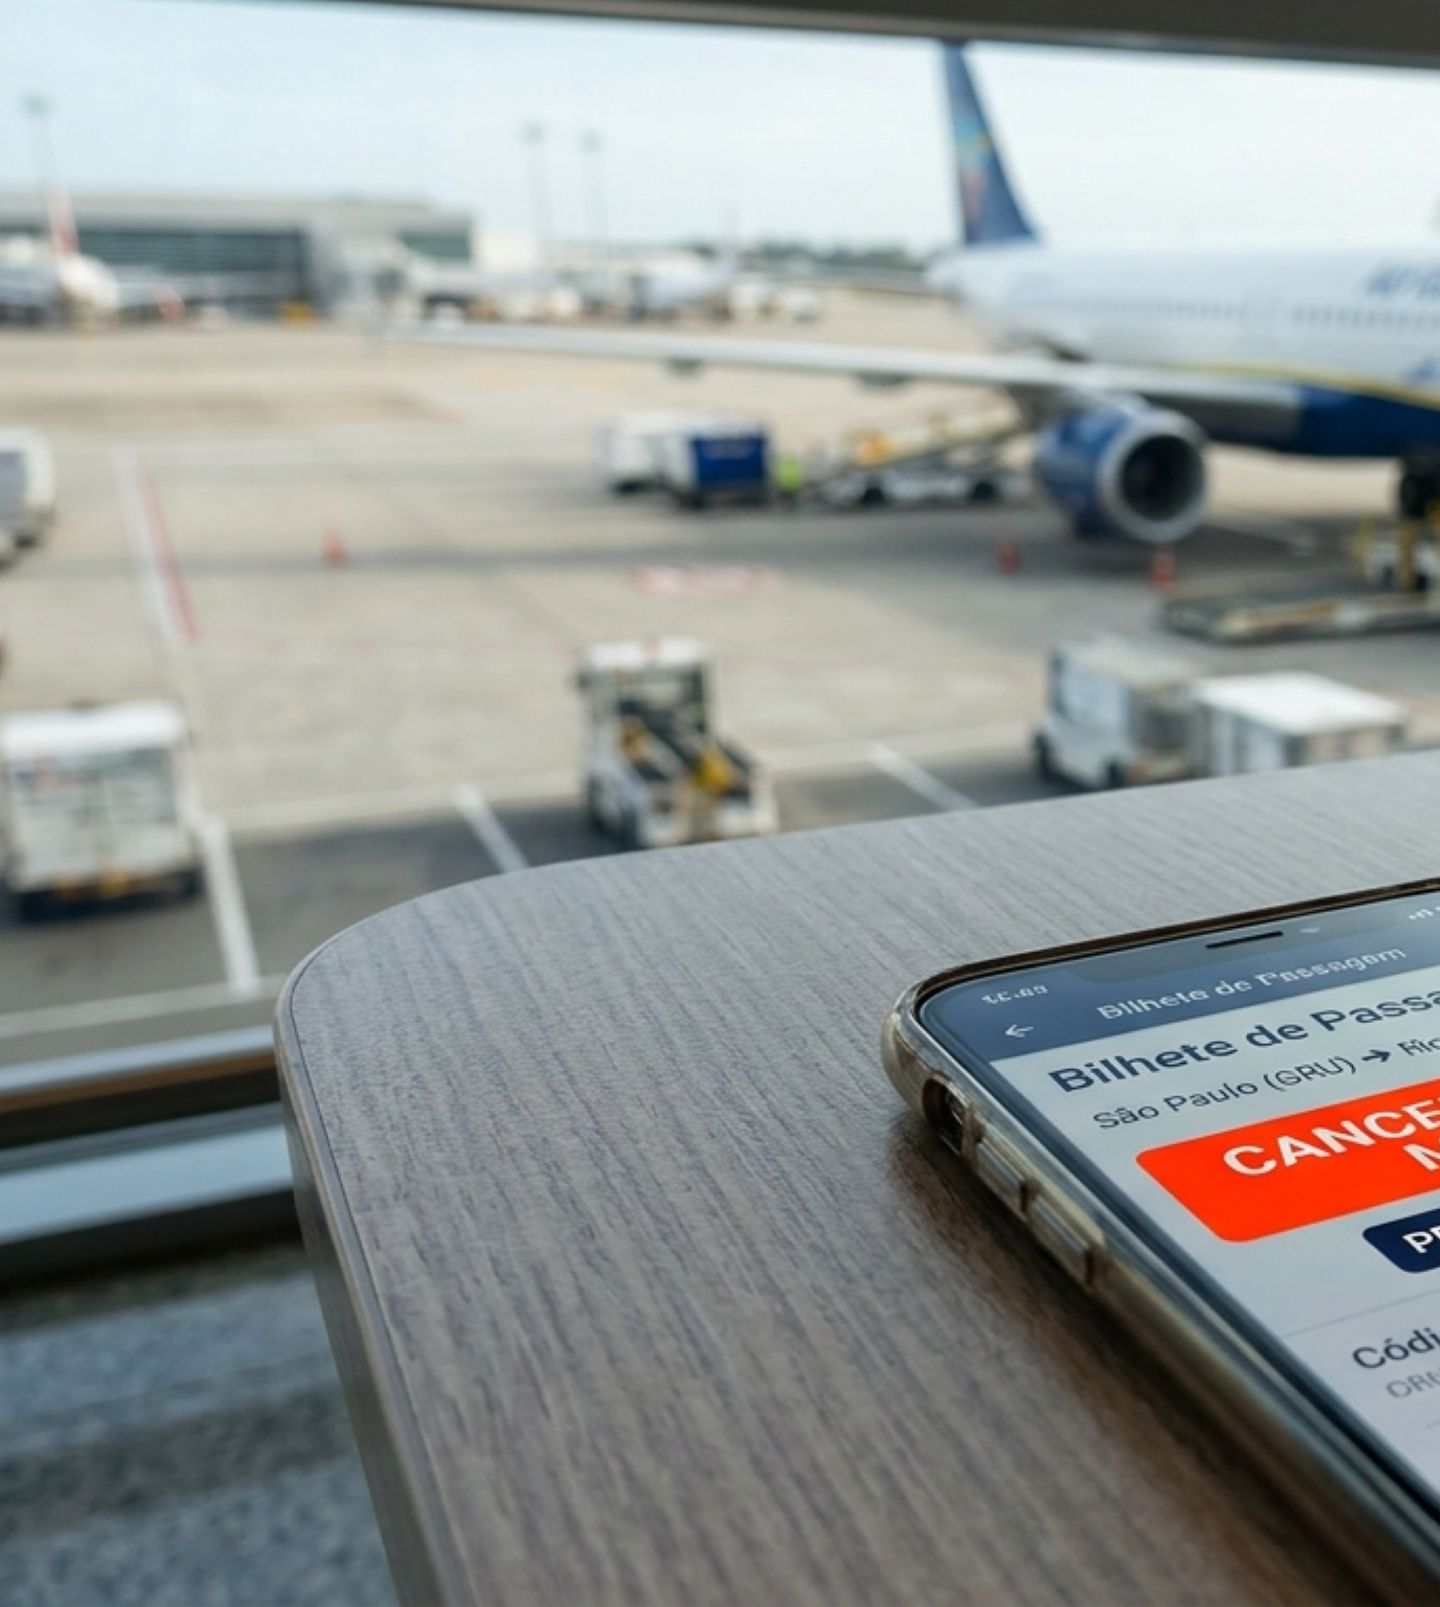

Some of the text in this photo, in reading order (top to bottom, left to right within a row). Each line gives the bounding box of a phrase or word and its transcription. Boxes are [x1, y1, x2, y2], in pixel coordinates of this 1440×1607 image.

[1215, 976, 1254, 997] de
[1047, 1038, 1239, 1094] Bilhete
[1245, 1014, 1310, 1050] de
[1093, 1100, 1161, 1131] São
[1165, 1078, 1260, 1114] Paulo
[1262, 1053, 1358, 1094] (GRU)
